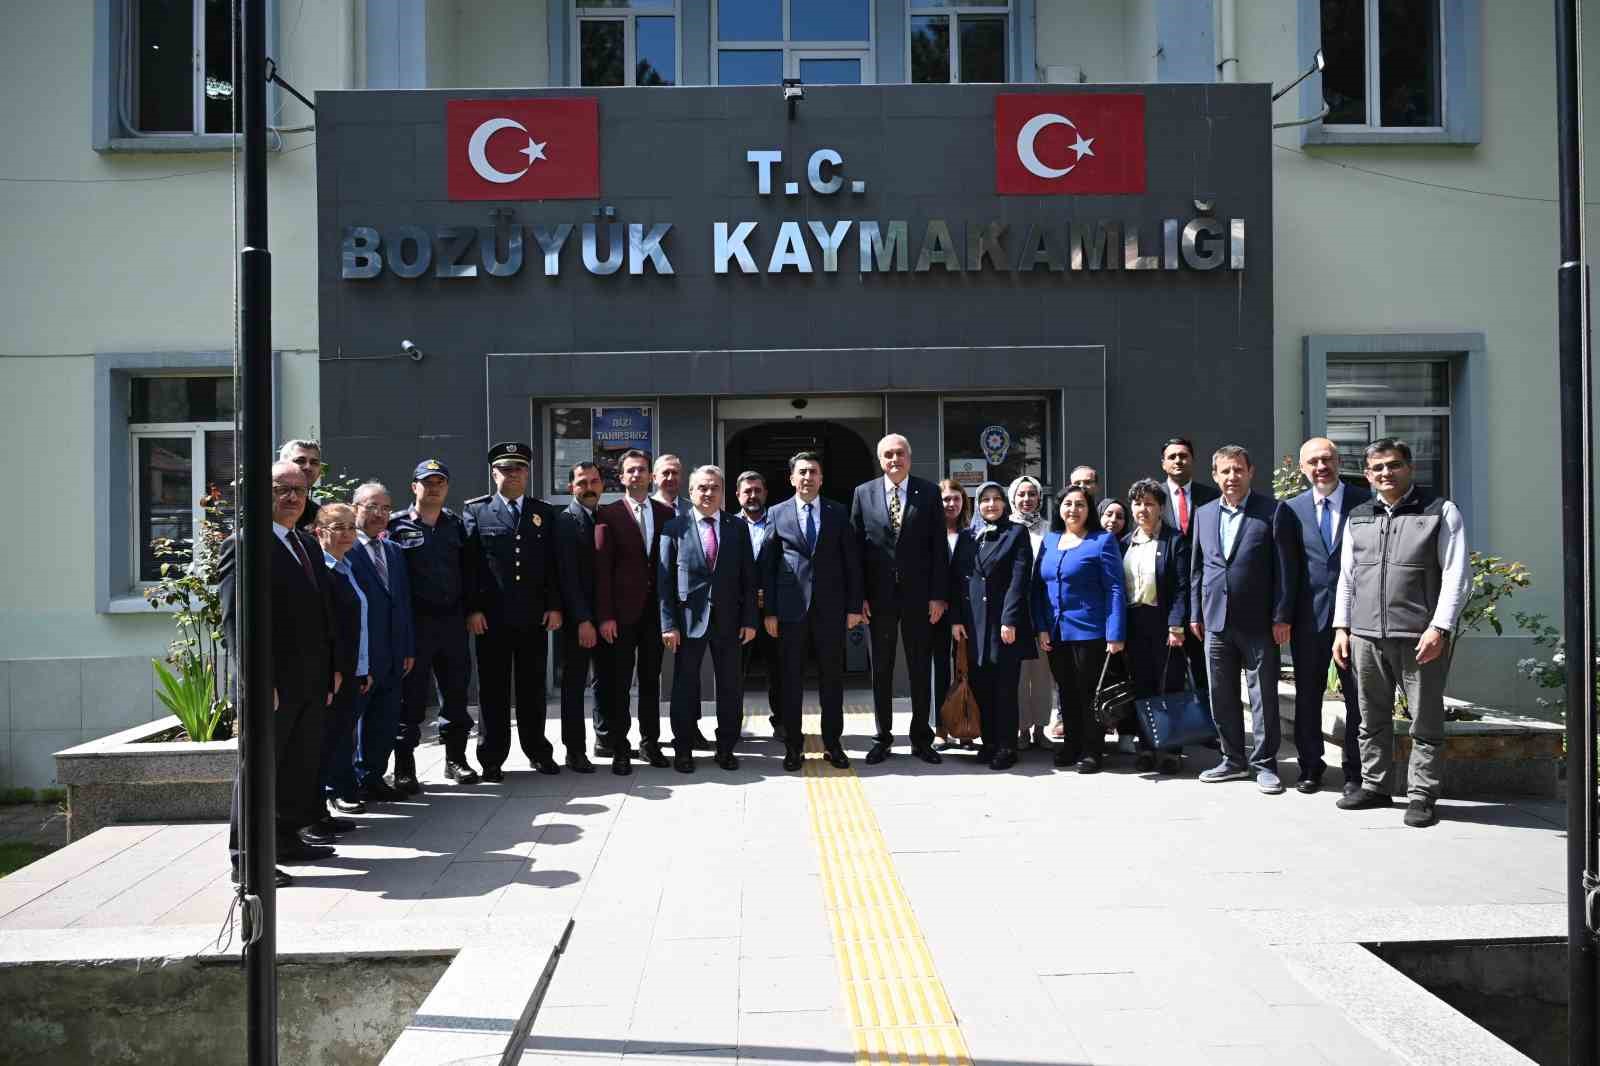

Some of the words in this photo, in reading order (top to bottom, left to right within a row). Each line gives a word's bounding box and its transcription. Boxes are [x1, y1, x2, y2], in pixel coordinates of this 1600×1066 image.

[746, 149, 867, 195] T.C.
[341, 206, 675, 280] BOZÜYÜK
[713, 199, 1245, 274] KAYMAKAMLIĞI
